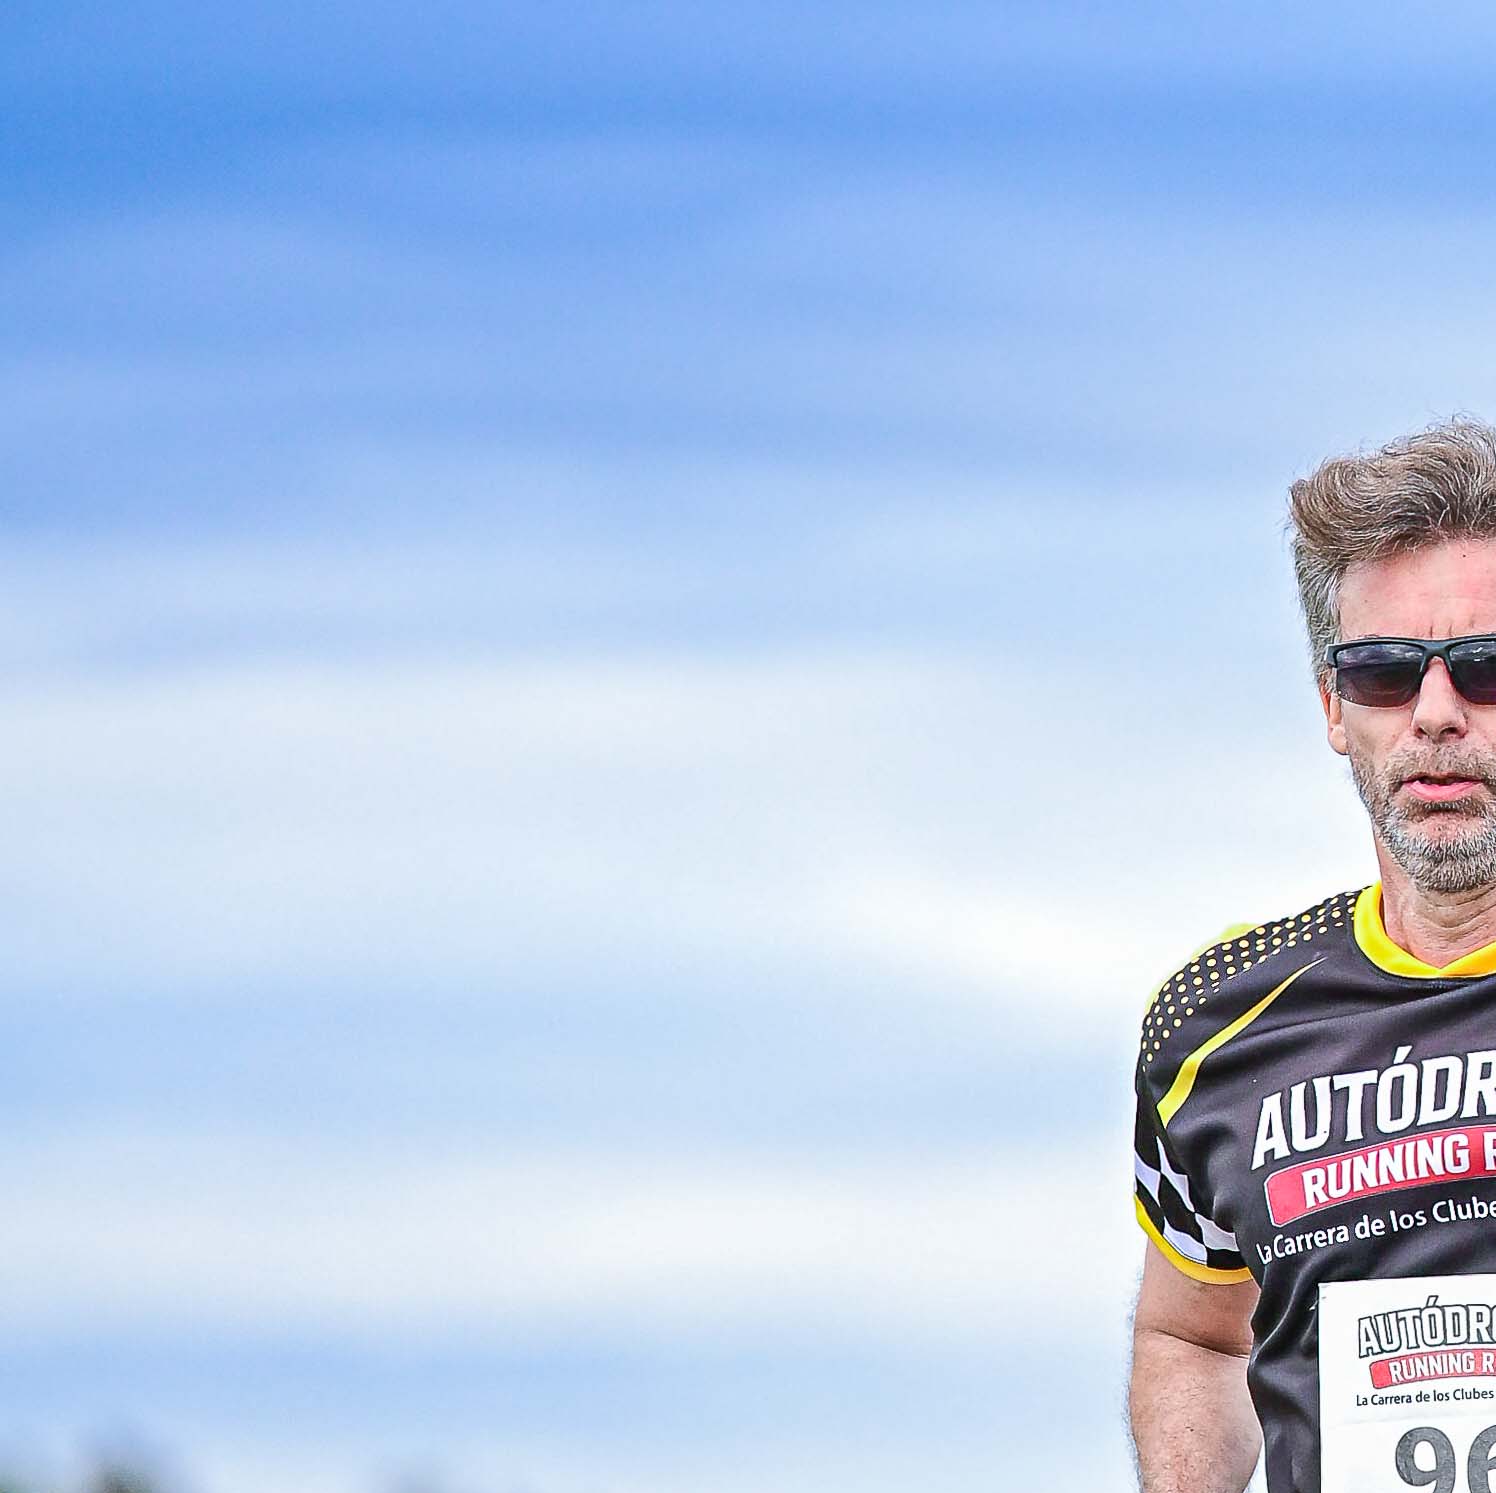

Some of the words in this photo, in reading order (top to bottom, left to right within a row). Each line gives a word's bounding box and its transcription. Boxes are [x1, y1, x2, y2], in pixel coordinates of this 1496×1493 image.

[1302, 1133, 1470, 1209] RUNNING
[1273, 1225, 1350, 1259] Carrera
[1354, 1214, 1386, 1240] de
[1389, 1210, 1427, 1232] los
[1388, 1352, 1476, 1383] RUNNING
[1356, 1394, 1368, 1406] La
[1370, 1394, 1412, 1405] Carrera
[1415, 1390, 1431, 1403] de
[1433, 1389, 1450, 1402] los
[1453, 1387, 1494, 1401] Clubes
